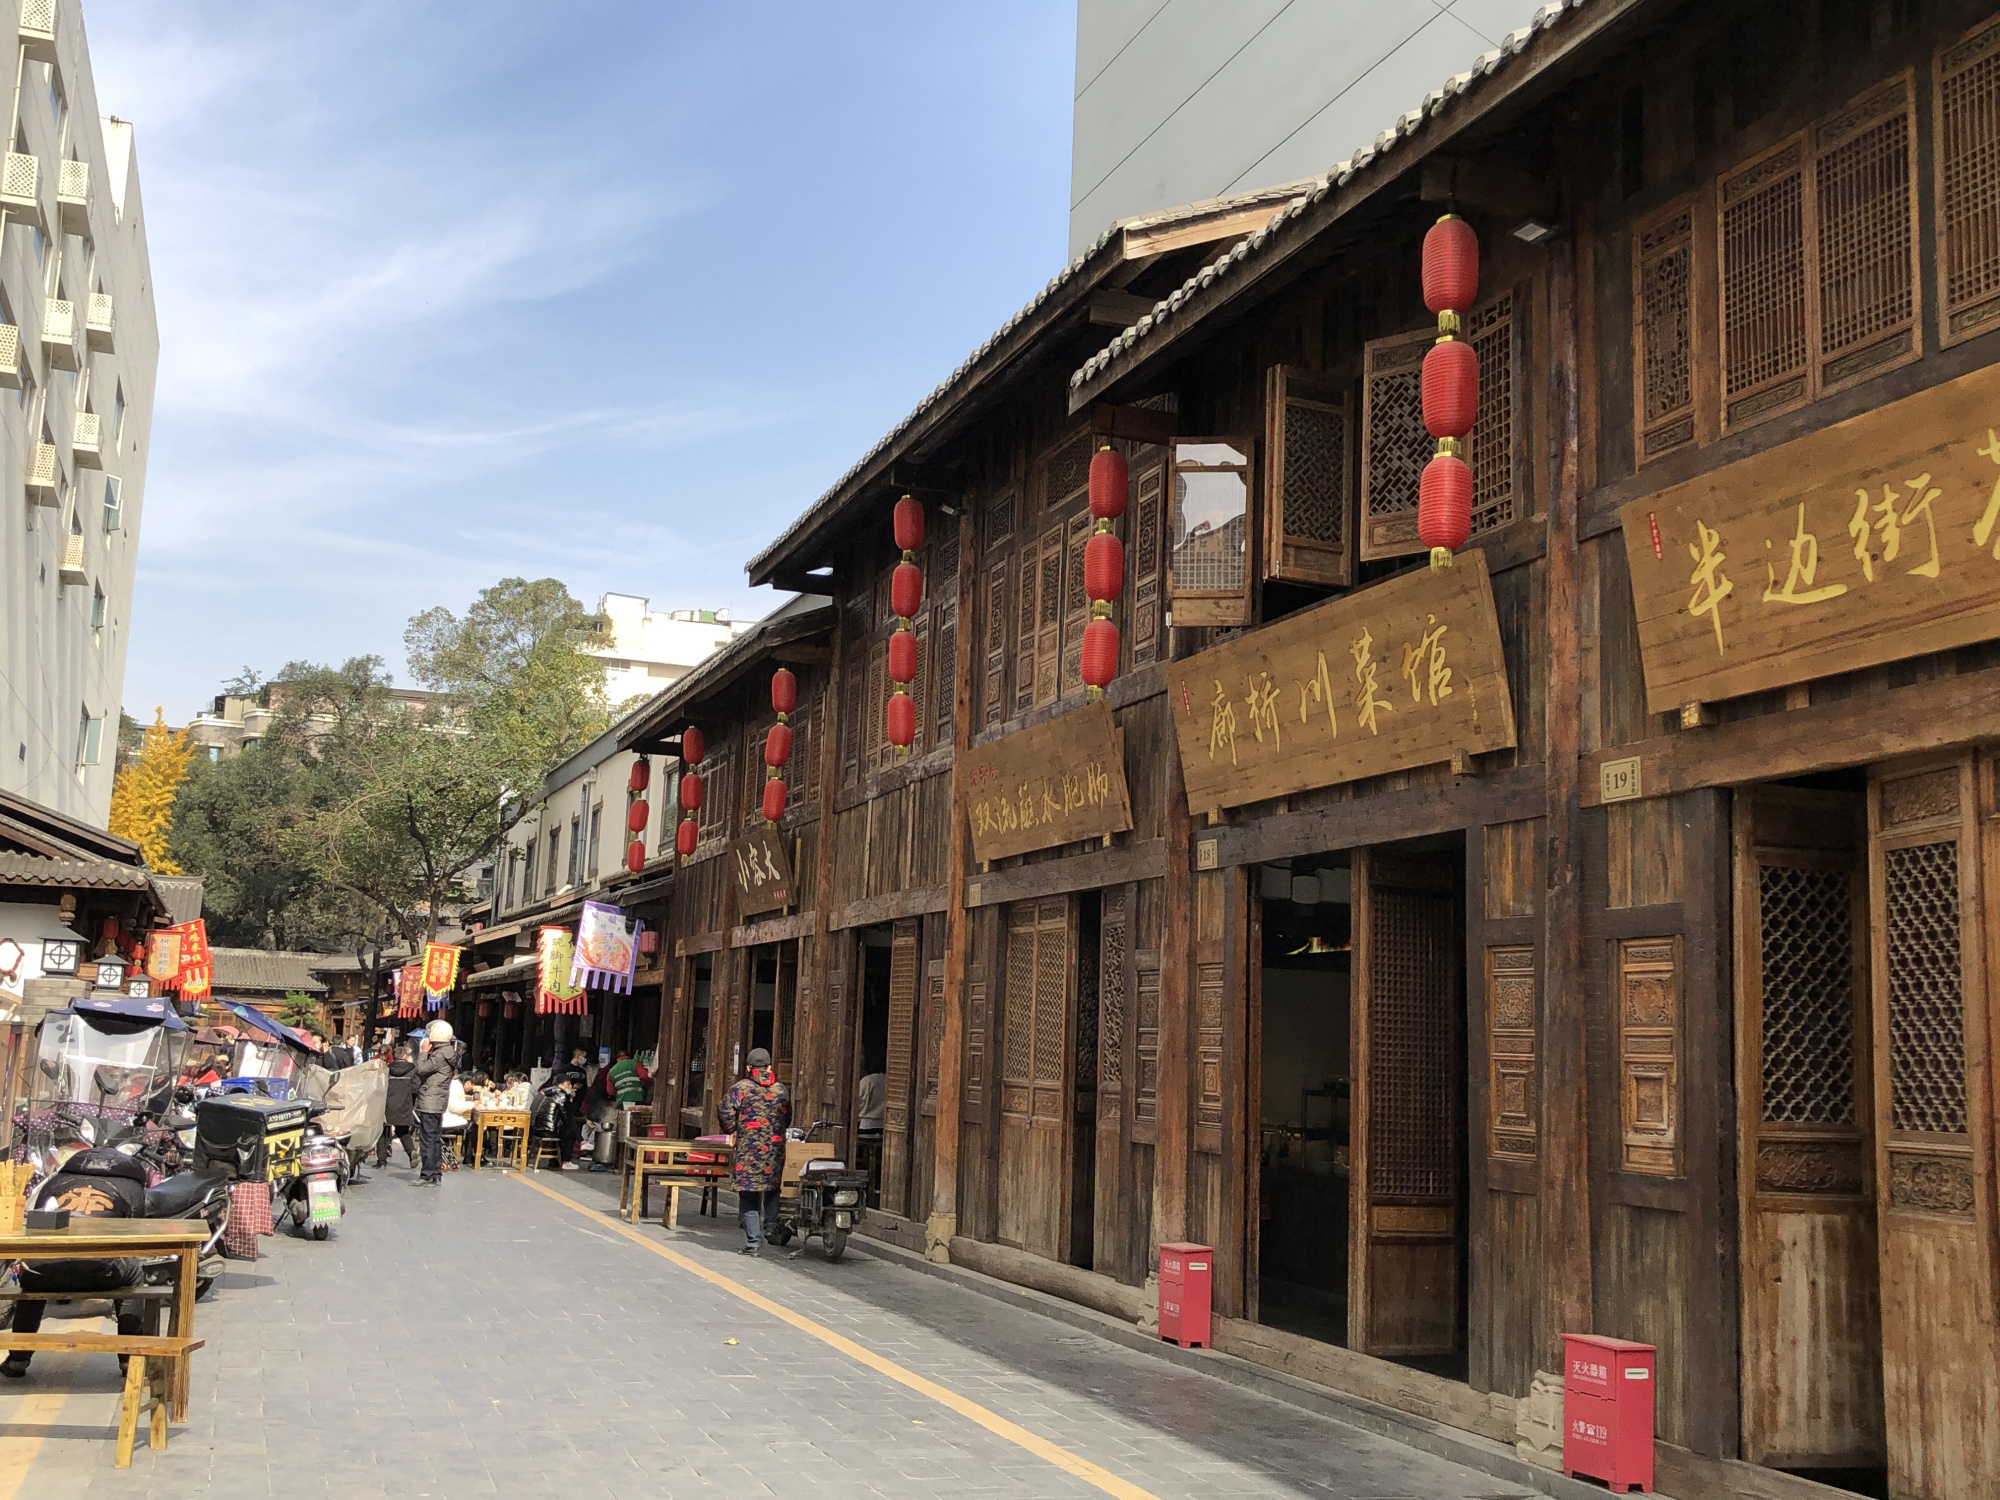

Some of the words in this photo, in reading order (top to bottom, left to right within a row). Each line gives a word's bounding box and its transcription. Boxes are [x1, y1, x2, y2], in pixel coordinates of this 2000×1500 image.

[1613, 771, 1628, 790] 19
[1572, 1360, 1607, 1379] 灭火器箱
